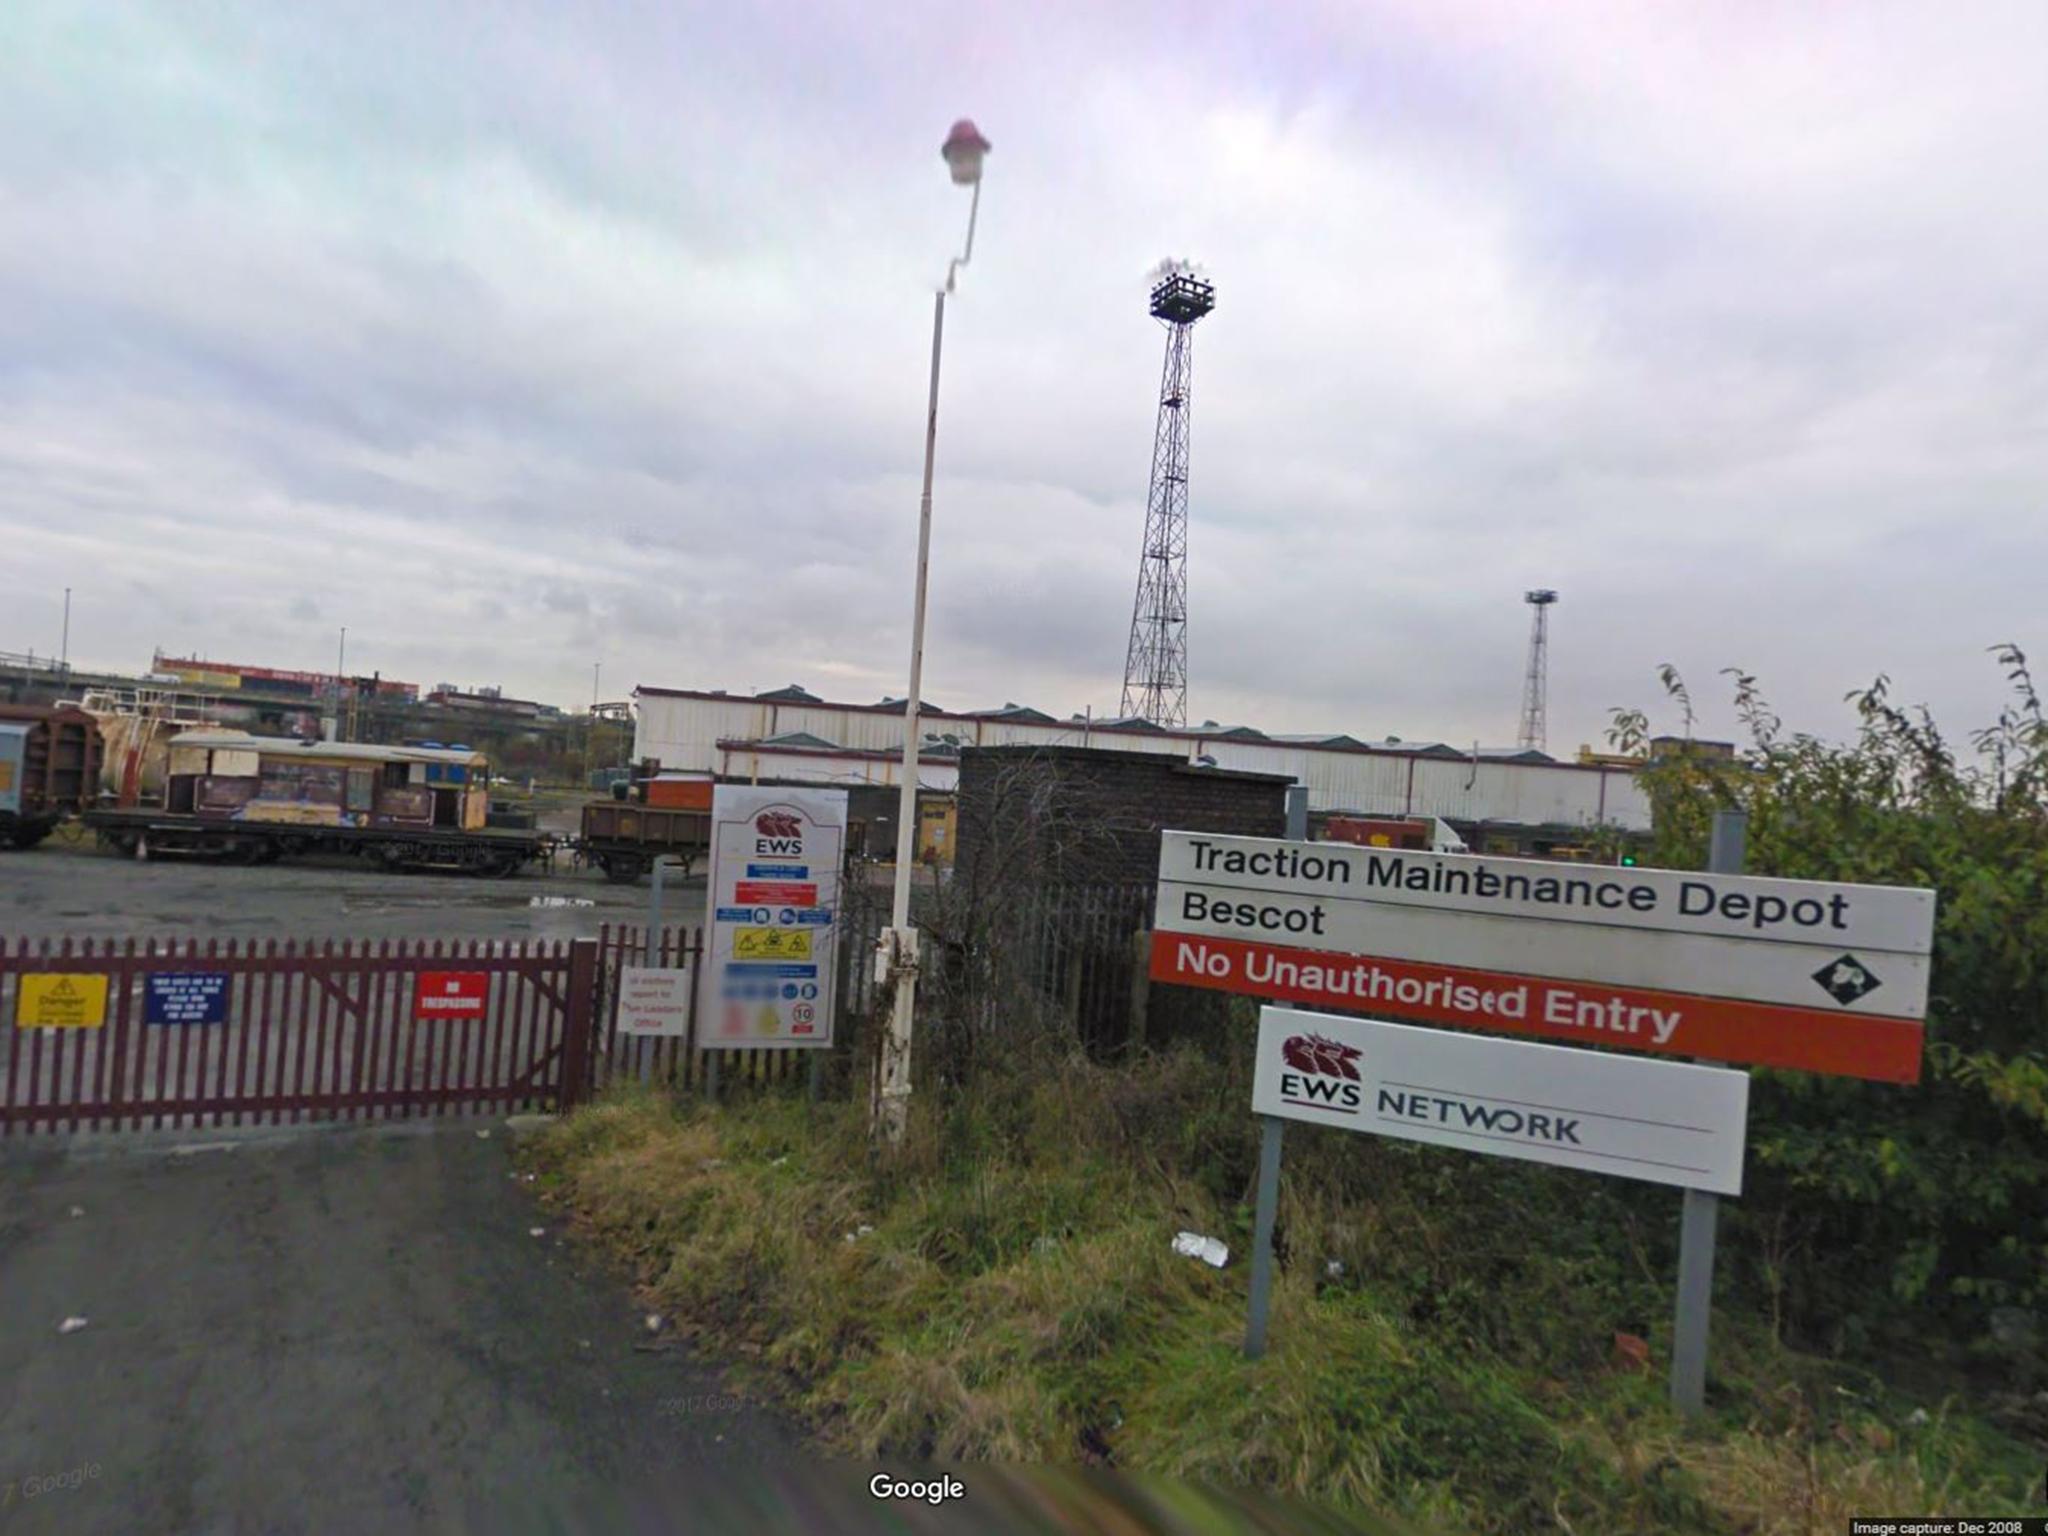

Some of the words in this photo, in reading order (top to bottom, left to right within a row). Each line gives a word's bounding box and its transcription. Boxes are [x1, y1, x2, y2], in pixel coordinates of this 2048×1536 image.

[756, 839, 802, 854] EWS
[1190, 841, 1350, 883] Traction
[1367, 856, 1657, 911] Maintenance
[1678, 882, 1849, 929] Depot
[1182, 892, 1325, 934] Bescot
[797, 1009, 812, 1019] 10
[1176, 942, 1231, 977] No
[1245, 952, 1528, 1018] Unauthorised
[1544, 989, 1682, 1044] Entry
[1281, 1074, 1361, 1106] EWS
[1378, 1090, 1581, 1144] NETWORK
